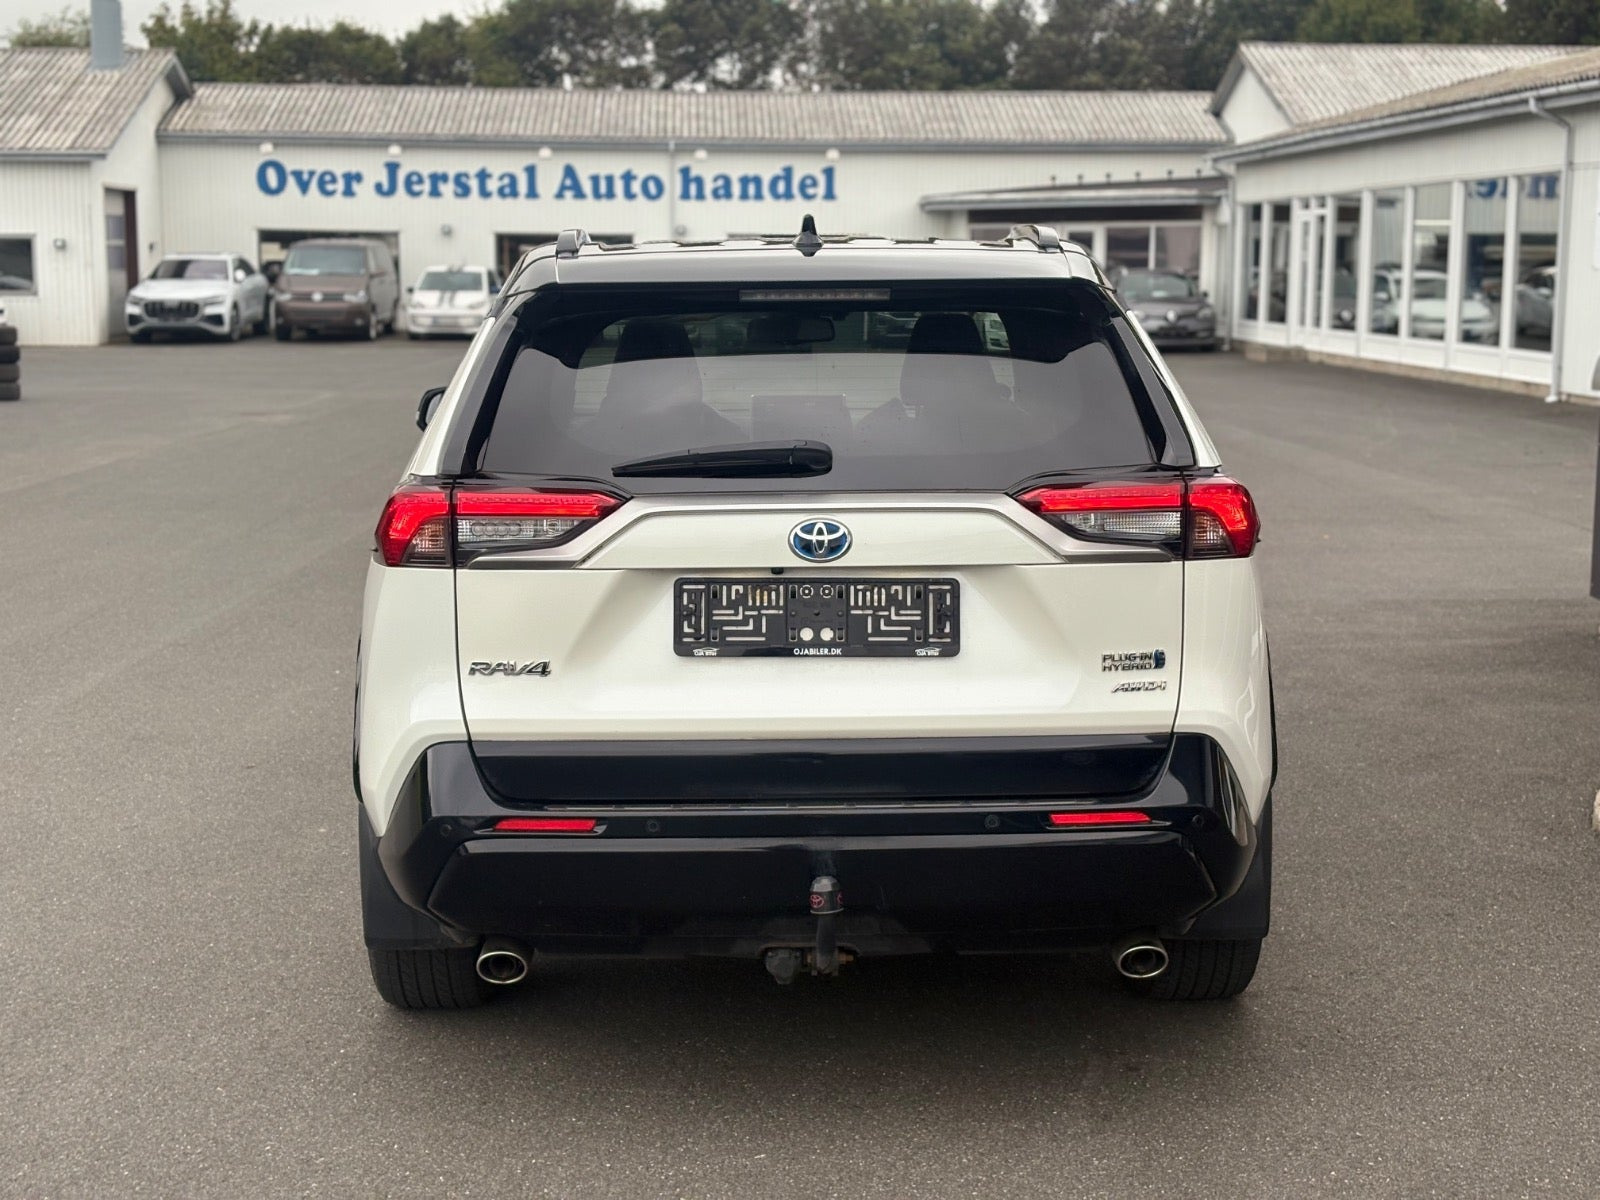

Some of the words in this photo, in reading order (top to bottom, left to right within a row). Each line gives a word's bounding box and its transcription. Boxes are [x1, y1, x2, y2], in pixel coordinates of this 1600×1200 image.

[256, 159, 363, 197] Over
[374, 161, 540, 200] Jerstal
[554, 163, 665, 201] Auto
[678, 165, 838, 201] handel
[793, 647, 842, 656] OJABILER.DK
[1102, 652, 1153, 663] PLUG-IN
[468, 660, 552, 677] RAV4
[1102, 662, 1153, 672] HYBRID
